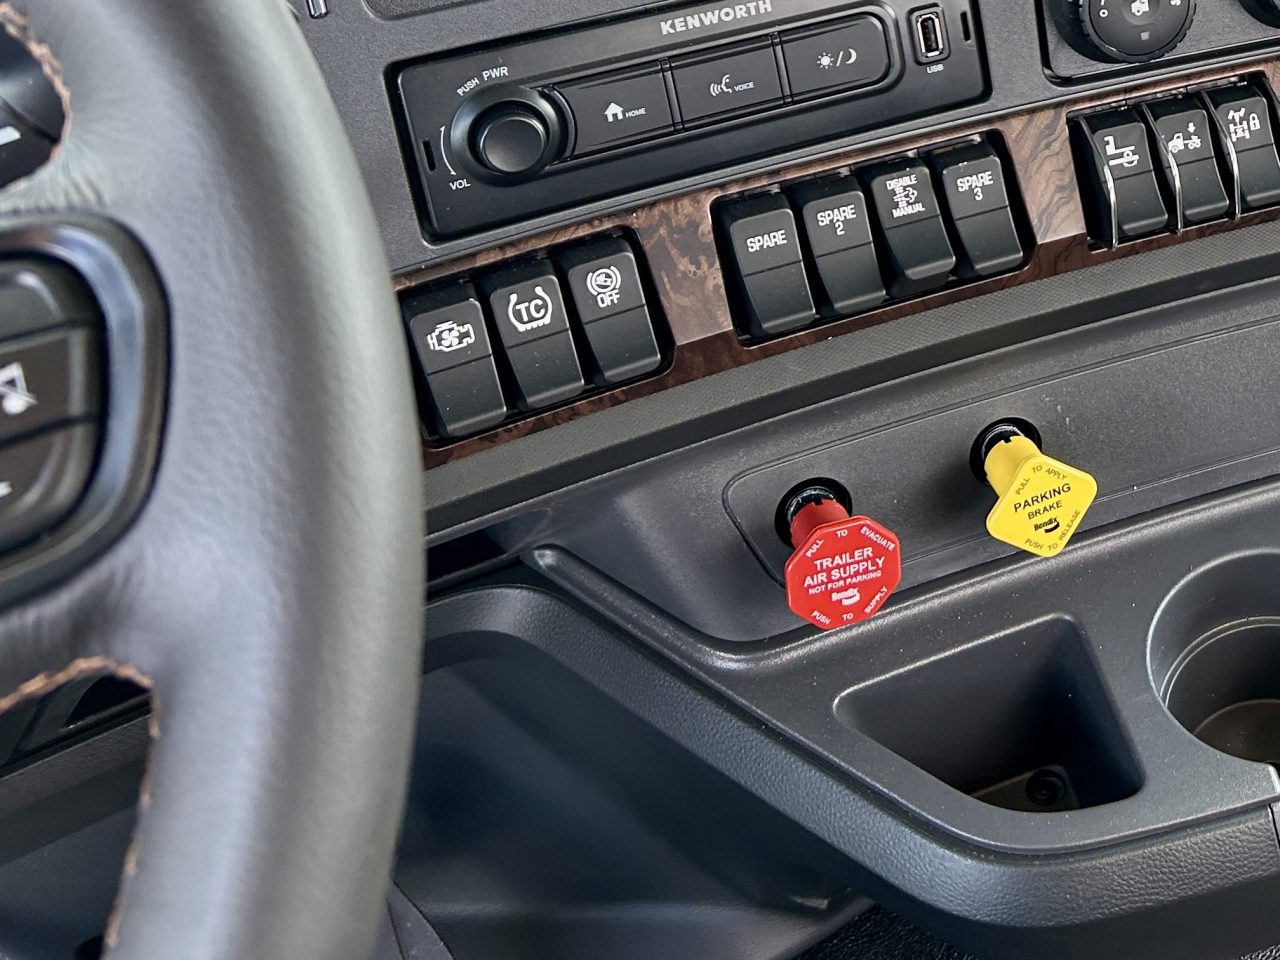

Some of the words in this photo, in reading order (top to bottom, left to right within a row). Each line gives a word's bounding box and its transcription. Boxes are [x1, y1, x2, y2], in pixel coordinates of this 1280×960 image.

[659, 0, 773, 36] KENWORTH
[926, 63, 944, 75] USB
[456, 77, 480, 97] PUSH
[482, 66, 509, 82] PWR
[733, 81, 755, 92] VOICE
[625, 107, 647, 119] HOME
[449, 179, 471, 191] VOL
[885, 174, 918, 191] DISABLE
[956, 170, 994, 192] SPARE
[974, 187, 984, 201] 3
[816, 204, 857, 227] SPARE
[892, 202, 926, 219] MANUAL
[834, 221, 845, 236] 2
[746, 229, 788, 254] SPARE
[596, 289, 620, 308] OFF
[515, 298, 546, 322] TC
[1015, 477, 1030, 495] PULL
[1031, 464, 1043, 474] TO
[1045, 467, 1067, 481] APPLY
[1013, 482, 1072, 513] PARKING
[1027, 499, 1063, 520] BRAKE
[1024, 537, 1044, 550] PUSH
[1047, 542, 1059, 551] TO
[1058, 509, 1081, 541] RELEASE
[1033, 516, 1059, 532] Bendix
[805, 539, 824, 558] PULL
[836, 529, 848, 538] TO
[860, 526, 896, 551] EVACUATE
[813, 546, 874, 571] TRAILER
[803, 572, 828, 587] AIR
[831, 556, 885, 580] SUPPLY
[808, 584, 826, 596] NOT
[827, 580, 845, 591] FOR
[846, 570, 882, 586] PARKING
[811, 610, 831, 625] PUSH
[841, 612, 854, 621] TO
[864, 586, 888, 614] SUPPLY
[831, 587, 860, 602] Bendix
